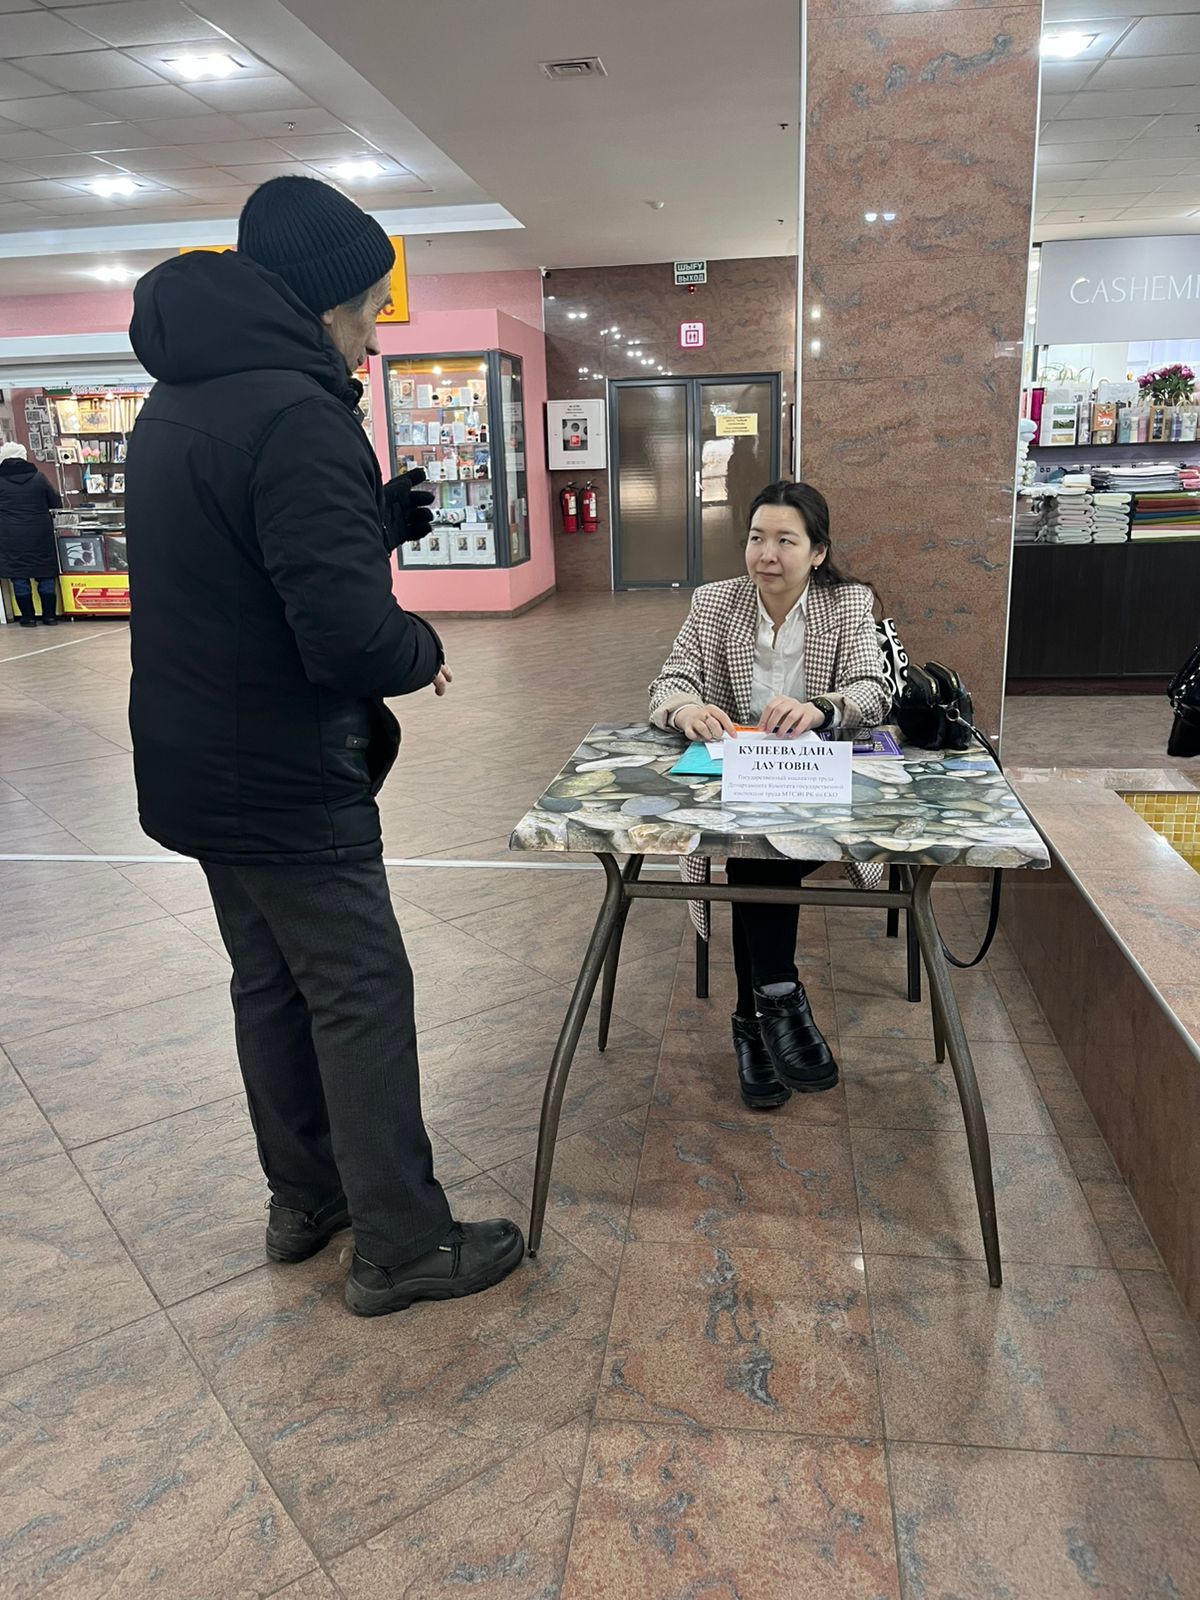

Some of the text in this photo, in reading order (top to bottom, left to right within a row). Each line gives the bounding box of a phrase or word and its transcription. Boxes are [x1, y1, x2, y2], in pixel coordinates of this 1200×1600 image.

[678, 274, 704, 282] ВЫХОД
[739, 745, 834, 757] КУПЕЕВА ДАНА
[752, 761, 820, 771] ДАУТОВНА
